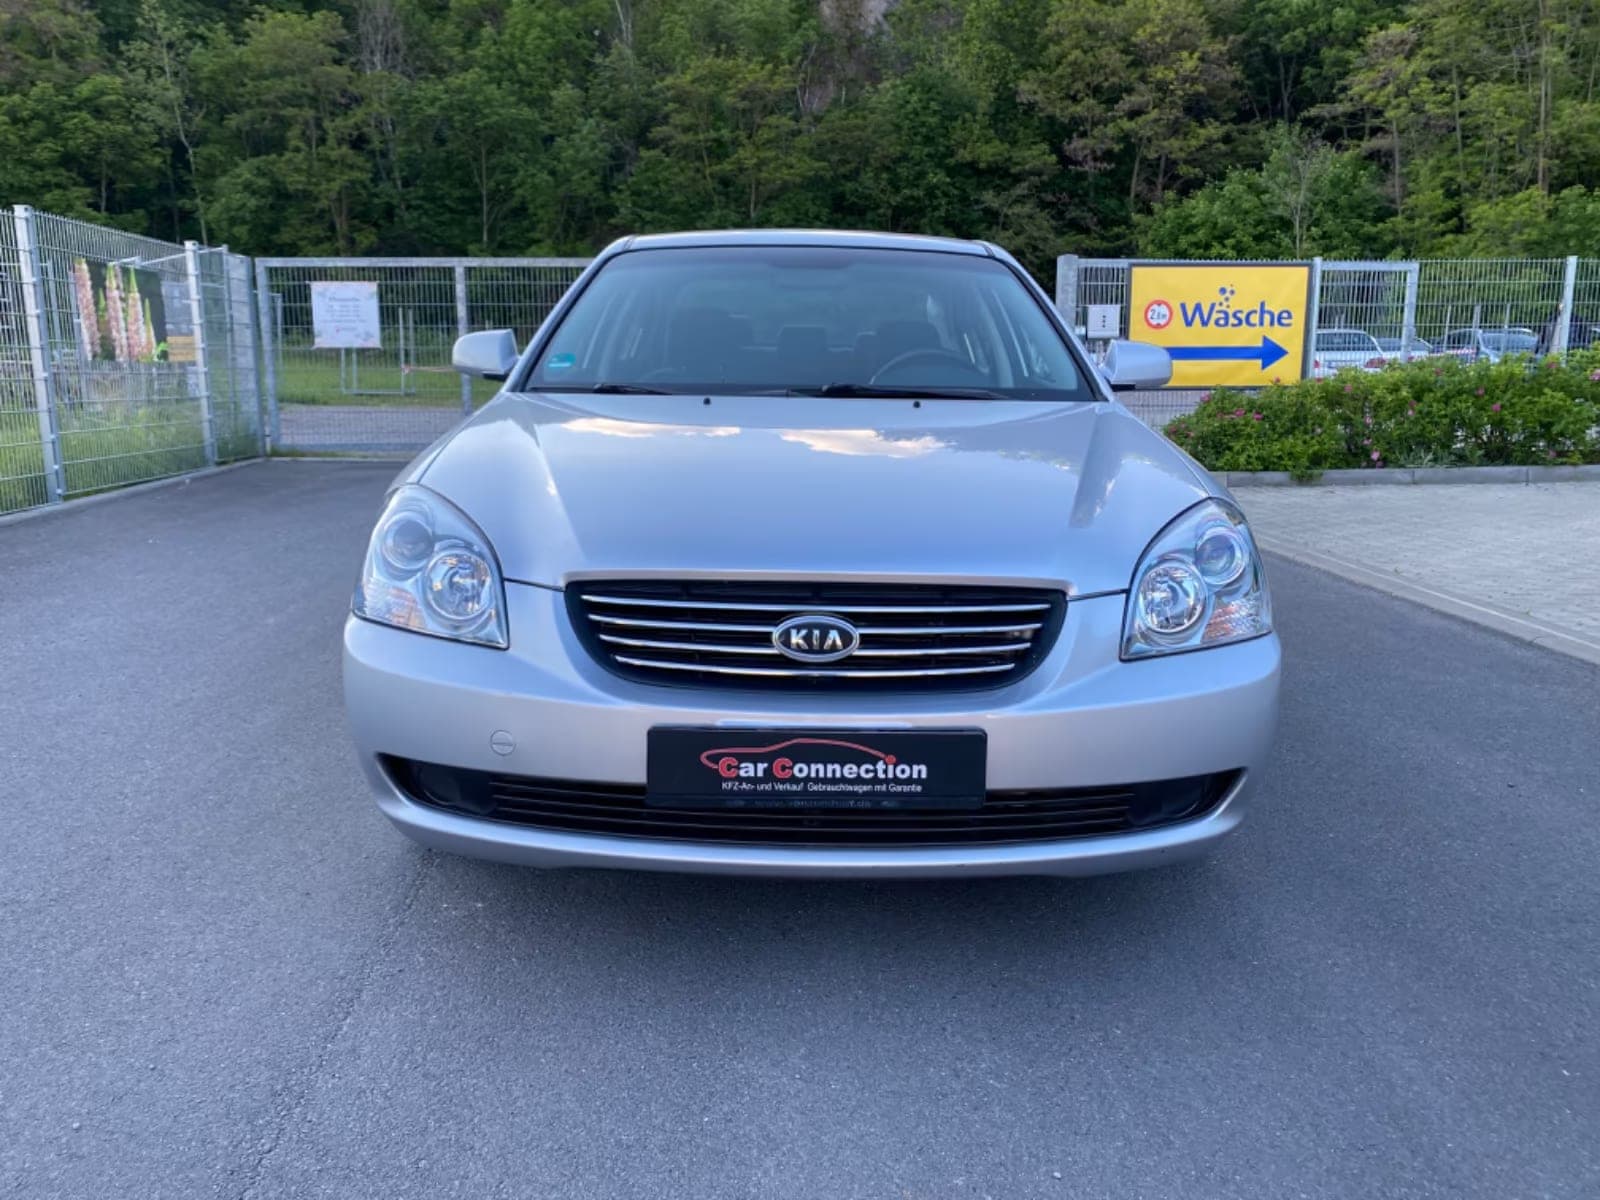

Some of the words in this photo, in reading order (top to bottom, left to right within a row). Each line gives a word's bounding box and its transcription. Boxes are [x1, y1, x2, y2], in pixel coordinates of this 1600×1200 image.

[1179, 300, 1293, 328] Wäsche
[790, 629, 843, 649] KIA
[719, 757, 768, 778] Car
[773, 755, 927, 779] Connection
[757, 782, 772, 791] und
[773, 782, 804, 791] Verkauf
[875, 783, 887, 792] mit
[889, 783, 922, 793] Garantie
